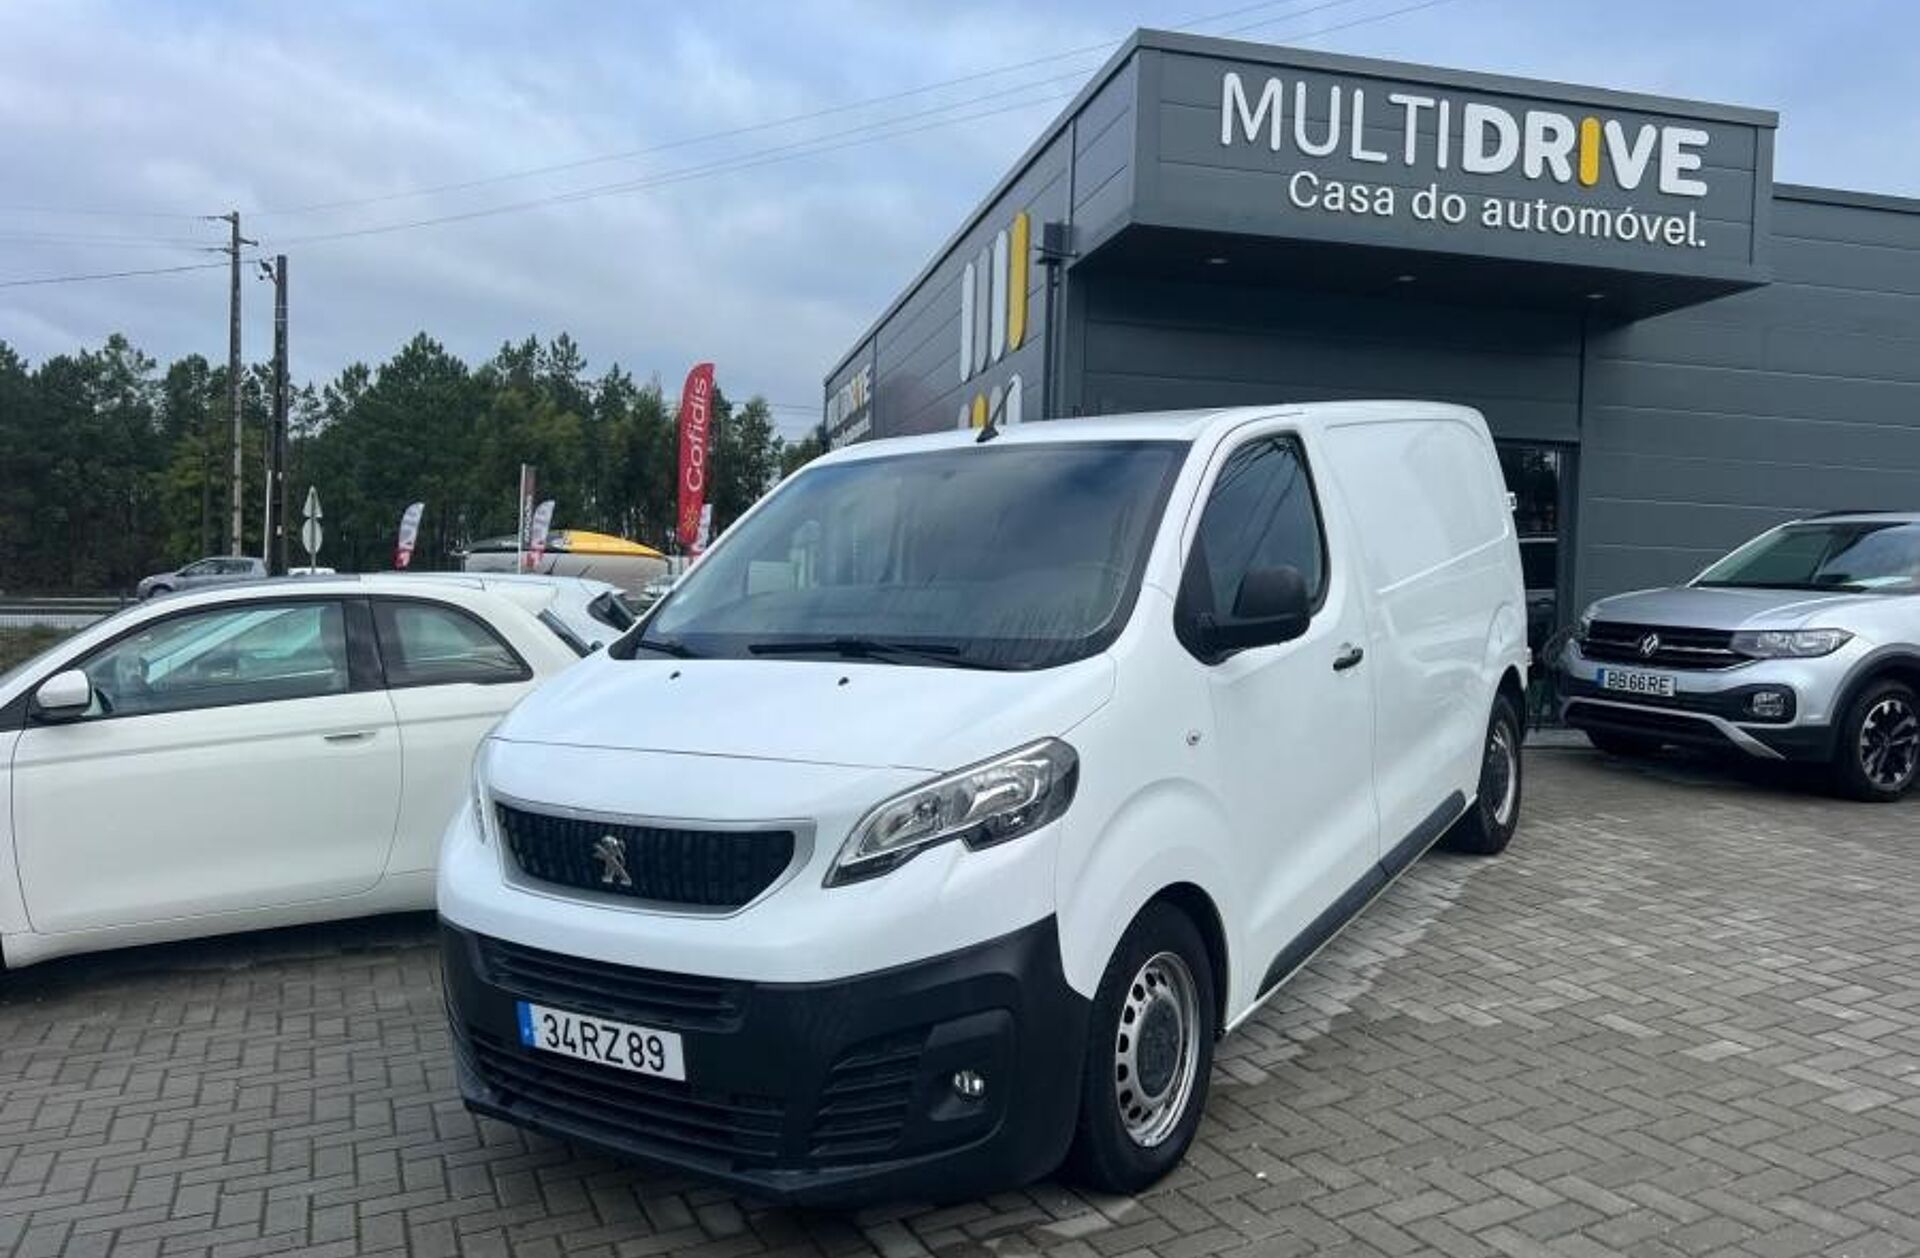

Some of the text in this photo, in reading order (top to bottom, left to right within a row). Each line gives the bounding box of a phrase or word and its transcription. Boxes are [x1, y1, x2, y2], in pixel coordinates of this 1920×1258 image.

[1221, 72, 1709, 196] MULTIDRIVE
[1288, 170, 1707, 248] Casa do automóvel.
[687, 377, 707, 492] Cofidis
[543, 1013, 665, 1073] 34RZ89
